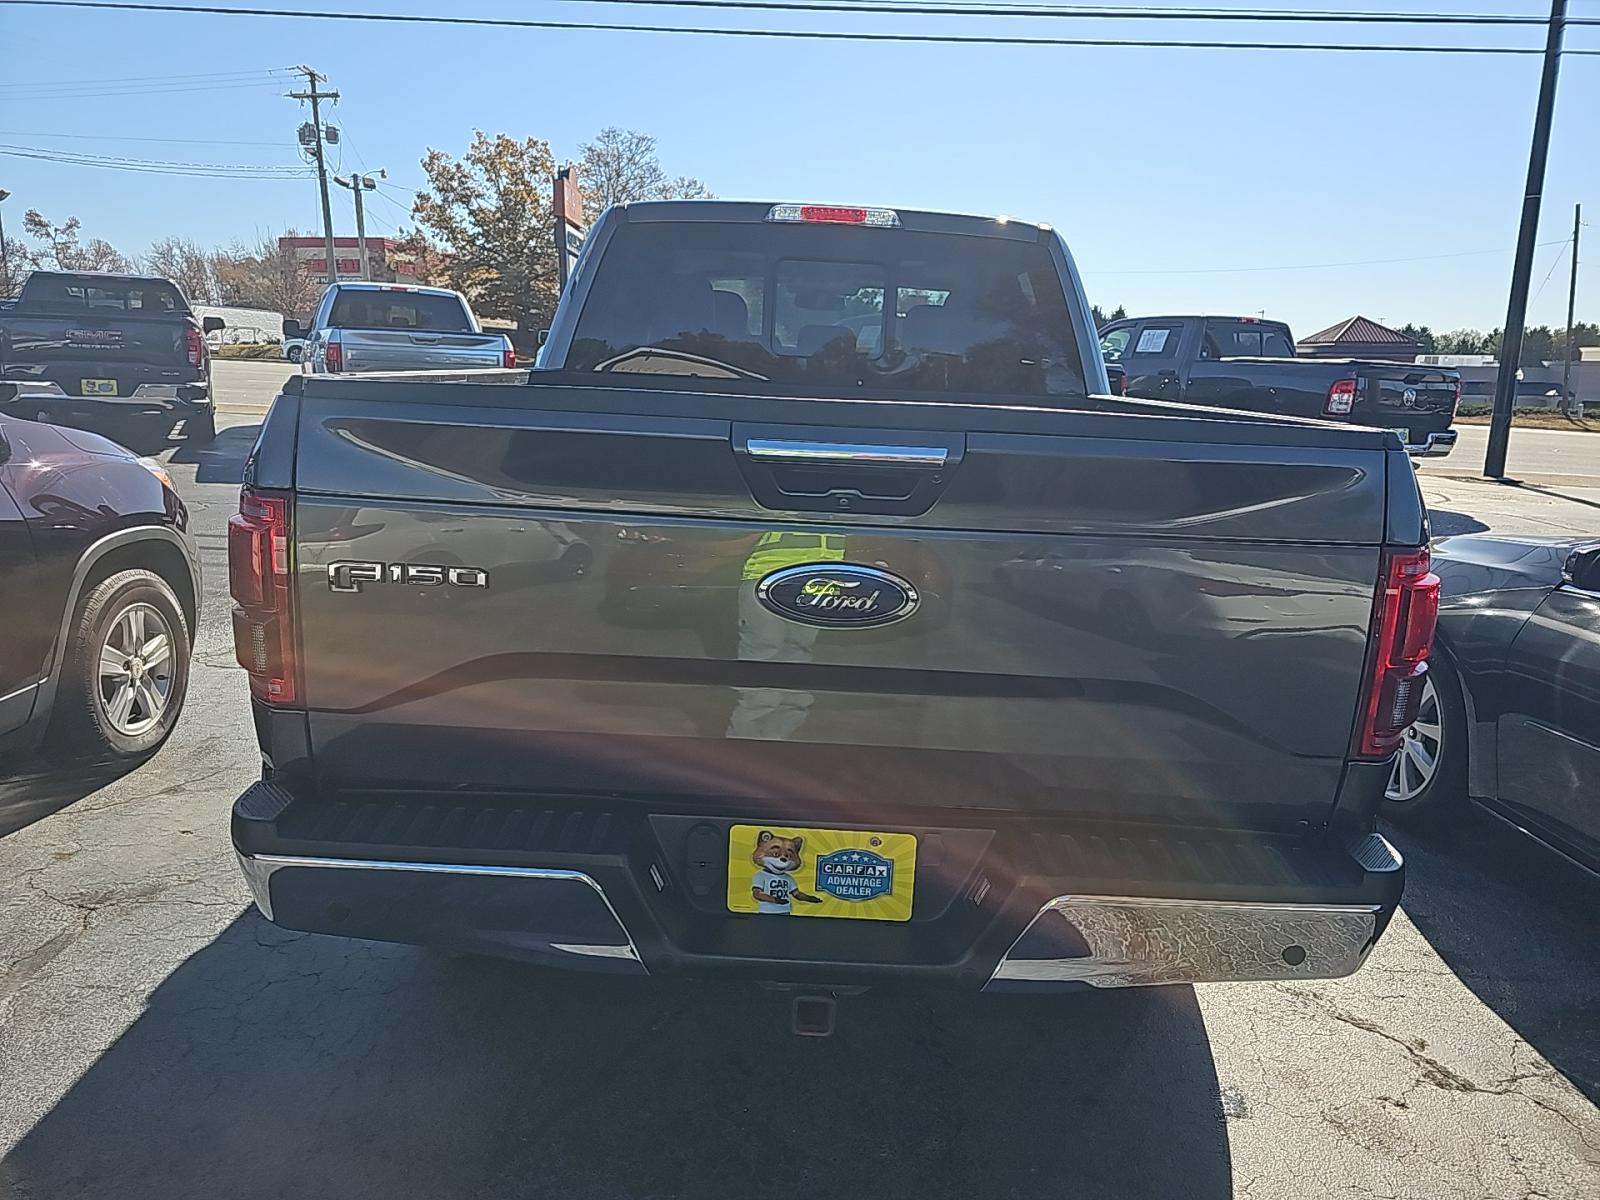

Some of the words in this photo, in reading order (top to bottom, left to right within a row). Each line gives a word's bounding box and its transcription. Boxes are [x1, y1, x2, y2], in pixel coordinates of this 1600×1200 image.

[796, 578, 880, 613] Ford
[823, 863, 887, 878] CARFAX
[769, 879, 789, 889] CAR
[826, 875, 882, 888] ADVANTAGE
[769, 889, 789, 899] FOX
[835, 886, 872, 896] DEALER
